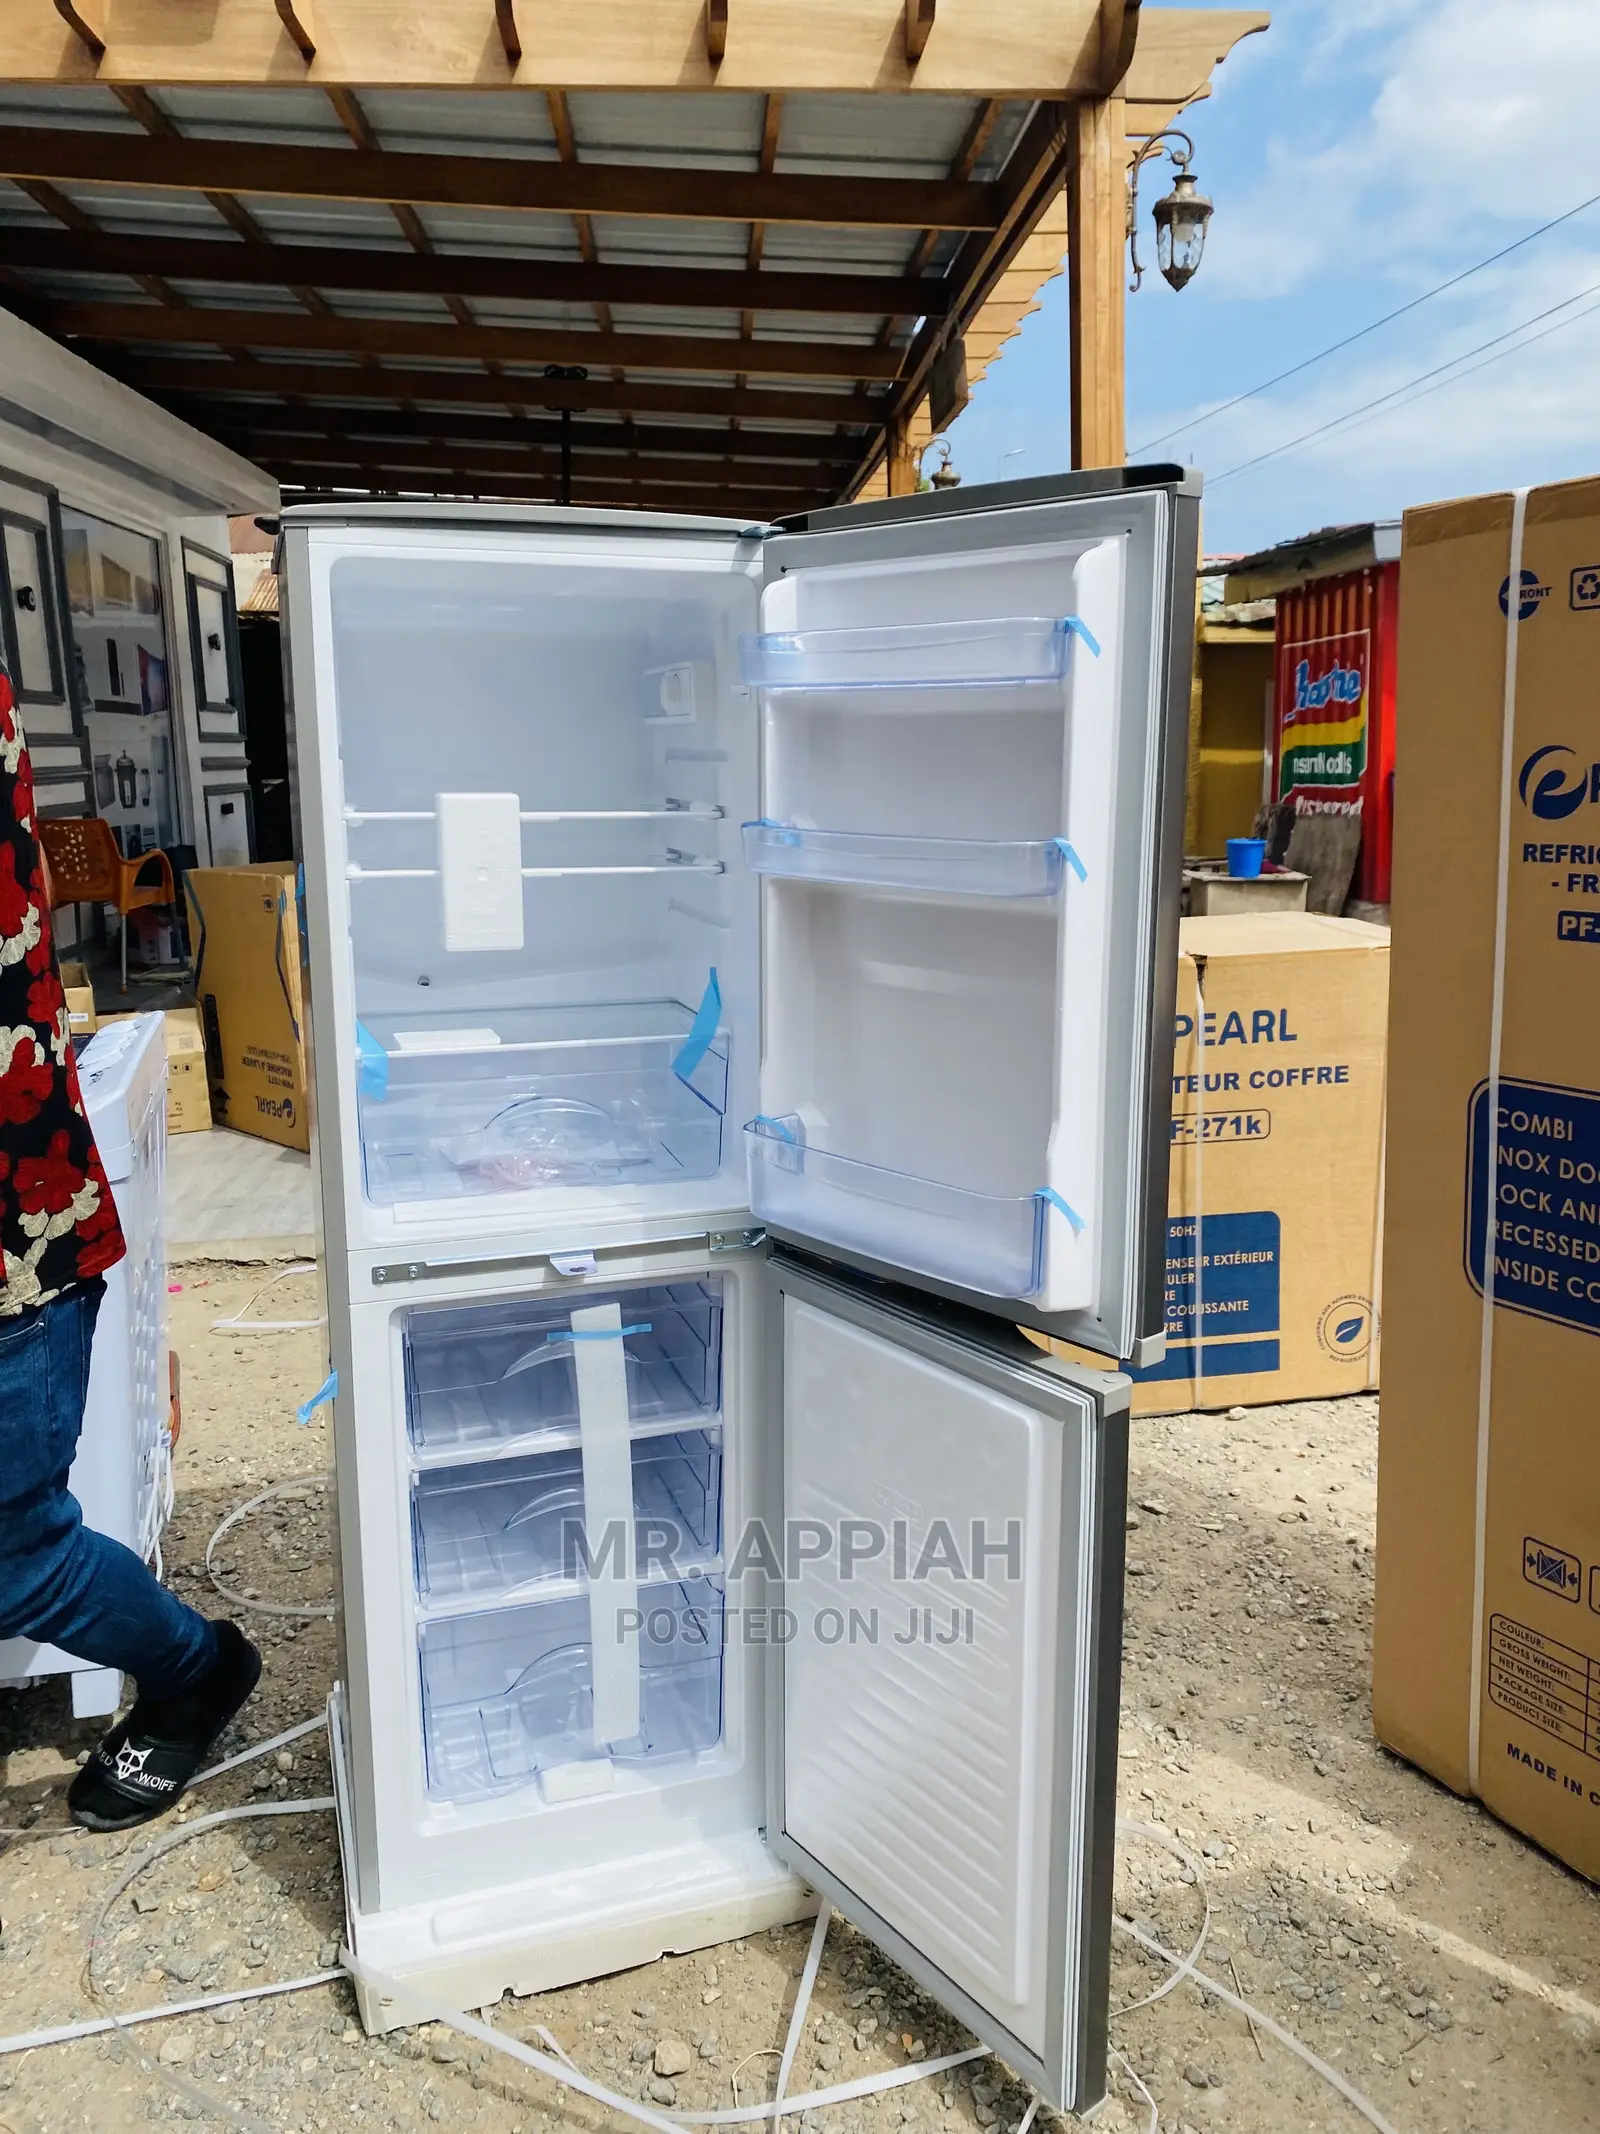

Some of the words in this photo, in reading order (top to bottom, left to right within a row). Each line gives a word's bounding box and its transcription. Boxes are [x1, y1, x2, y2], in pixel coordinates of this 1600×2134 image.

[1515, 586, 1553, 599] RONT
[1523, 843, 1600, 865] REFRI
[1175, 1008, 1298, 1048] PEARL
[1249, 1065, 1350, 1089] COFFRE
[1496, 1107, 1573, 1141] COMBI
[1495, 1144, 1550, 1175] NOX
[1559, 1157, 1600, 1184] DO
[1494, 1184, 1552, 1213] OCK
[1560, 1198, 1600, 1225] AN
[1213, 1250, 1274, 1265] EXTÉRIEUR
[1492, 1255, 1559, 1291] NSIDE
[1166, 1300, 1250, 1317] COUISSANTE
[1499, 1621, 1545, 1649] COULEUR:
[1498, 1655, 1515, 1671] NET
[1499, 1639, 1530, 1660] GROSS
[1532, 1654, 1572, 1682] WEIGHT:
[1498, 1673, 1544, 1704] PACKAGE
[1497, 1691, 1540, 1721] PRODUCT
[1506, 1742, 1557, 1782] MADE
[1563, 1774, 1583, 1797] IN
